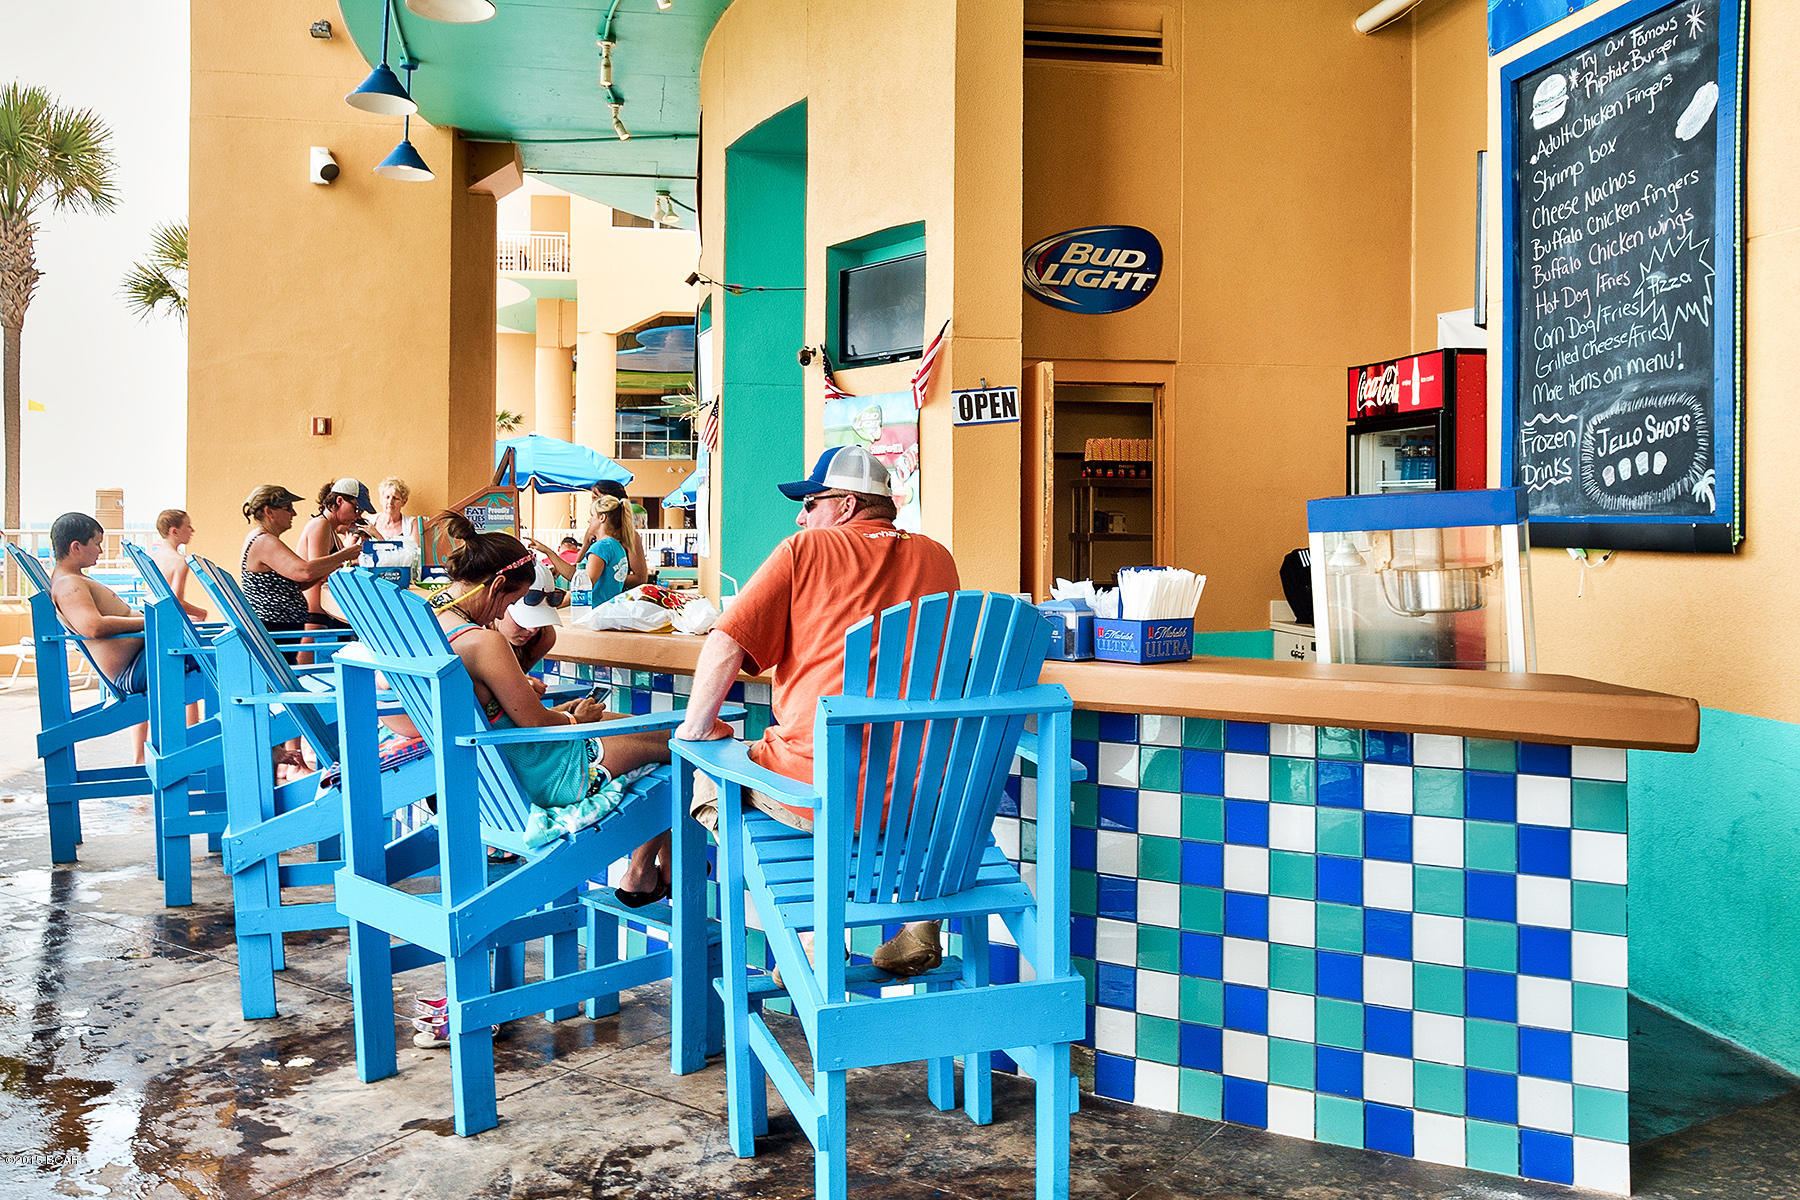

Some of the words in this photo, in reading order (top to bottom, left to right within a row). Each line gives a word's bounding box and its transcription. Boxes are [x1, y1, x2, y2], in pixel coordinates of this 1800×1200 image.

[1576, 50, 1597, 75] Try
[1630, 16, 1678, 49] Famous
[1580, 60, 1629, 98] Riptide
[1629, 35, 1678, 72] Burger
[1572, 101, 1623, 139] Chicken
[1626, 73, 1673, 114] Fingers
[1533, 161, 1584, 202] Shrimp
[1588, 136, 1617, 169] box
[1531, 227, 1583, 261] Buffalo
[1641, 169, 1699, 213] fingers
[1532, 196, 1580, 229] Cheese
[1585, 169, 1636, 212] Nachos
[1060, 242, 1146, 269] BUD
[1531, 256, 1581, 289] Buffalo
[1589, 230, 1644, 265] Chicken
[1649, 208, 1694, 241] wings
[1040, 263, 1156, 291] LIGHT
[1646, 272, 1693, 297] Pizza
[1536, 290, 1560, 320] Hot
[1561, 286, 1592, 319] Dog
[1534, 325, 1565, 350] Corn
[1535, 345, 1579, 379] Grilled
[1533, 382, 1564, 405] More
[1568, 371, 1601, 396] items
[1603, 365, 1623, 384] on
[958, 391, 1017, 421] OPEN
[1521, 428, 1577, 457] Frozen
[1596, 427, 1643, 457] JELLO
[1645, 414, 1691, 444] SHOTS
[466, 507, 485, 515] FAT
[863, 530, 902, 539] carhart
[1096, 638, 1138, 653] ULTRA
[1145, 639, 1191, 658] ULTRA
